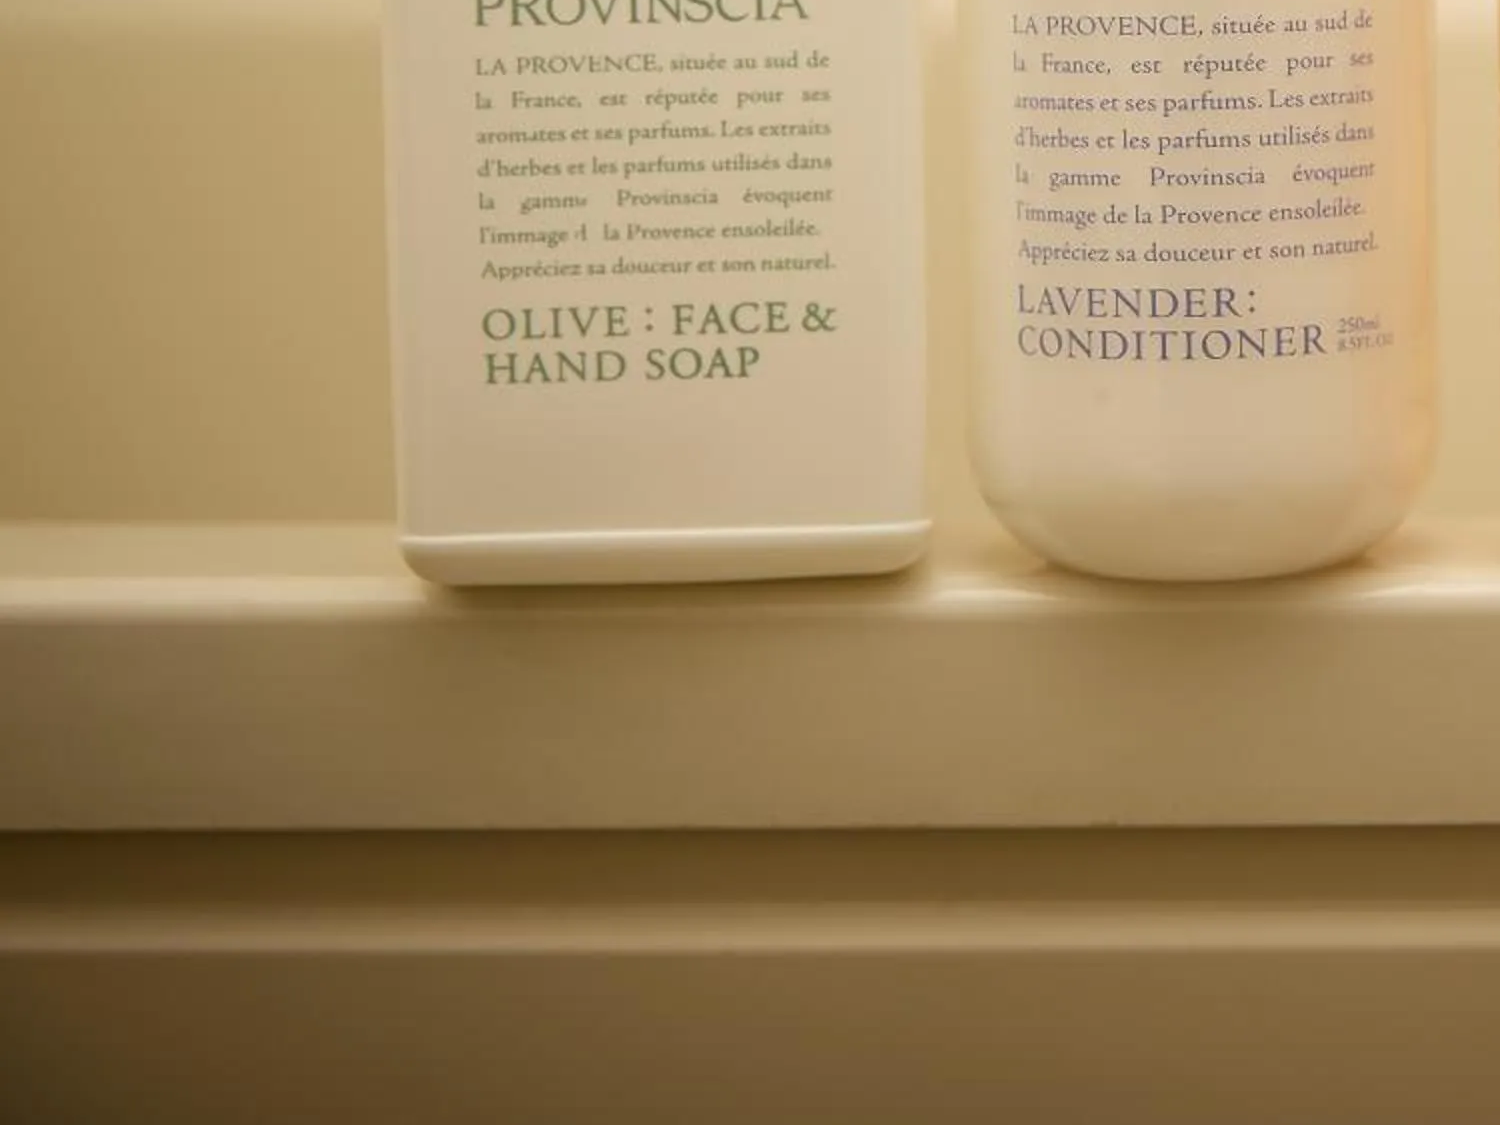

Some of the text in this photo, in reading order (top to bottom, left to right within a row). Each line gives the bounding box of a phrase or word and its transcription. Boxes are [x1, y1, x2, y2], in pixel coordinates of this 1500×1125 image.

[1012, 11, 1348, 39] LA PROVENCE, située au sud
[476, 51, 830, 76] LA PROVENCE, située au sud de
[1042, 54, 1333, 79] France, est réputée pour
[476, 89, 784, 110] la France, est réputée pour
[1100, 96, 1119, 110] et
[1126, 96, 1157, 110] ses
[1163, 91, 1263, 117] parfums.
[1270, 88, 1305, 108] Les
[477, 120, 831, 145] aromates parfums. Les extraits
[1015, 125, 1329, 155] d'herbes et les parfums utilisés
[592, 156, 618, 174] les
[624, 155, 705, 179] parfums
[712, 153, 780, 172] utilisés
[787, 153, 832, 171] dans
[1049, 161, 1375, 191] gamme Provinscia évoquent
[478, 192, 495, 210] la
[617, 189, 718, 207] Provinscia
[743, 187, 832, 207] évoquent
[1103, 202, 1261, 223] de la Provence
[603, 223, 620, 241] la
[626, 223, 715, 241] Provence
[1018, 240, 1305, 266] Appréciez sa douceur et son
[481, 253, 836, 281] Appréciez douceur et son naturel.
[1017, 285, 1257, 319] LAVENDER:
[673, 302, 790, 336] FACE
[802, 302, 837, 332] &
[1017, 324, 1327, 361] CONDITIONER
[484, 346, 759, 384] HAND SOAP
